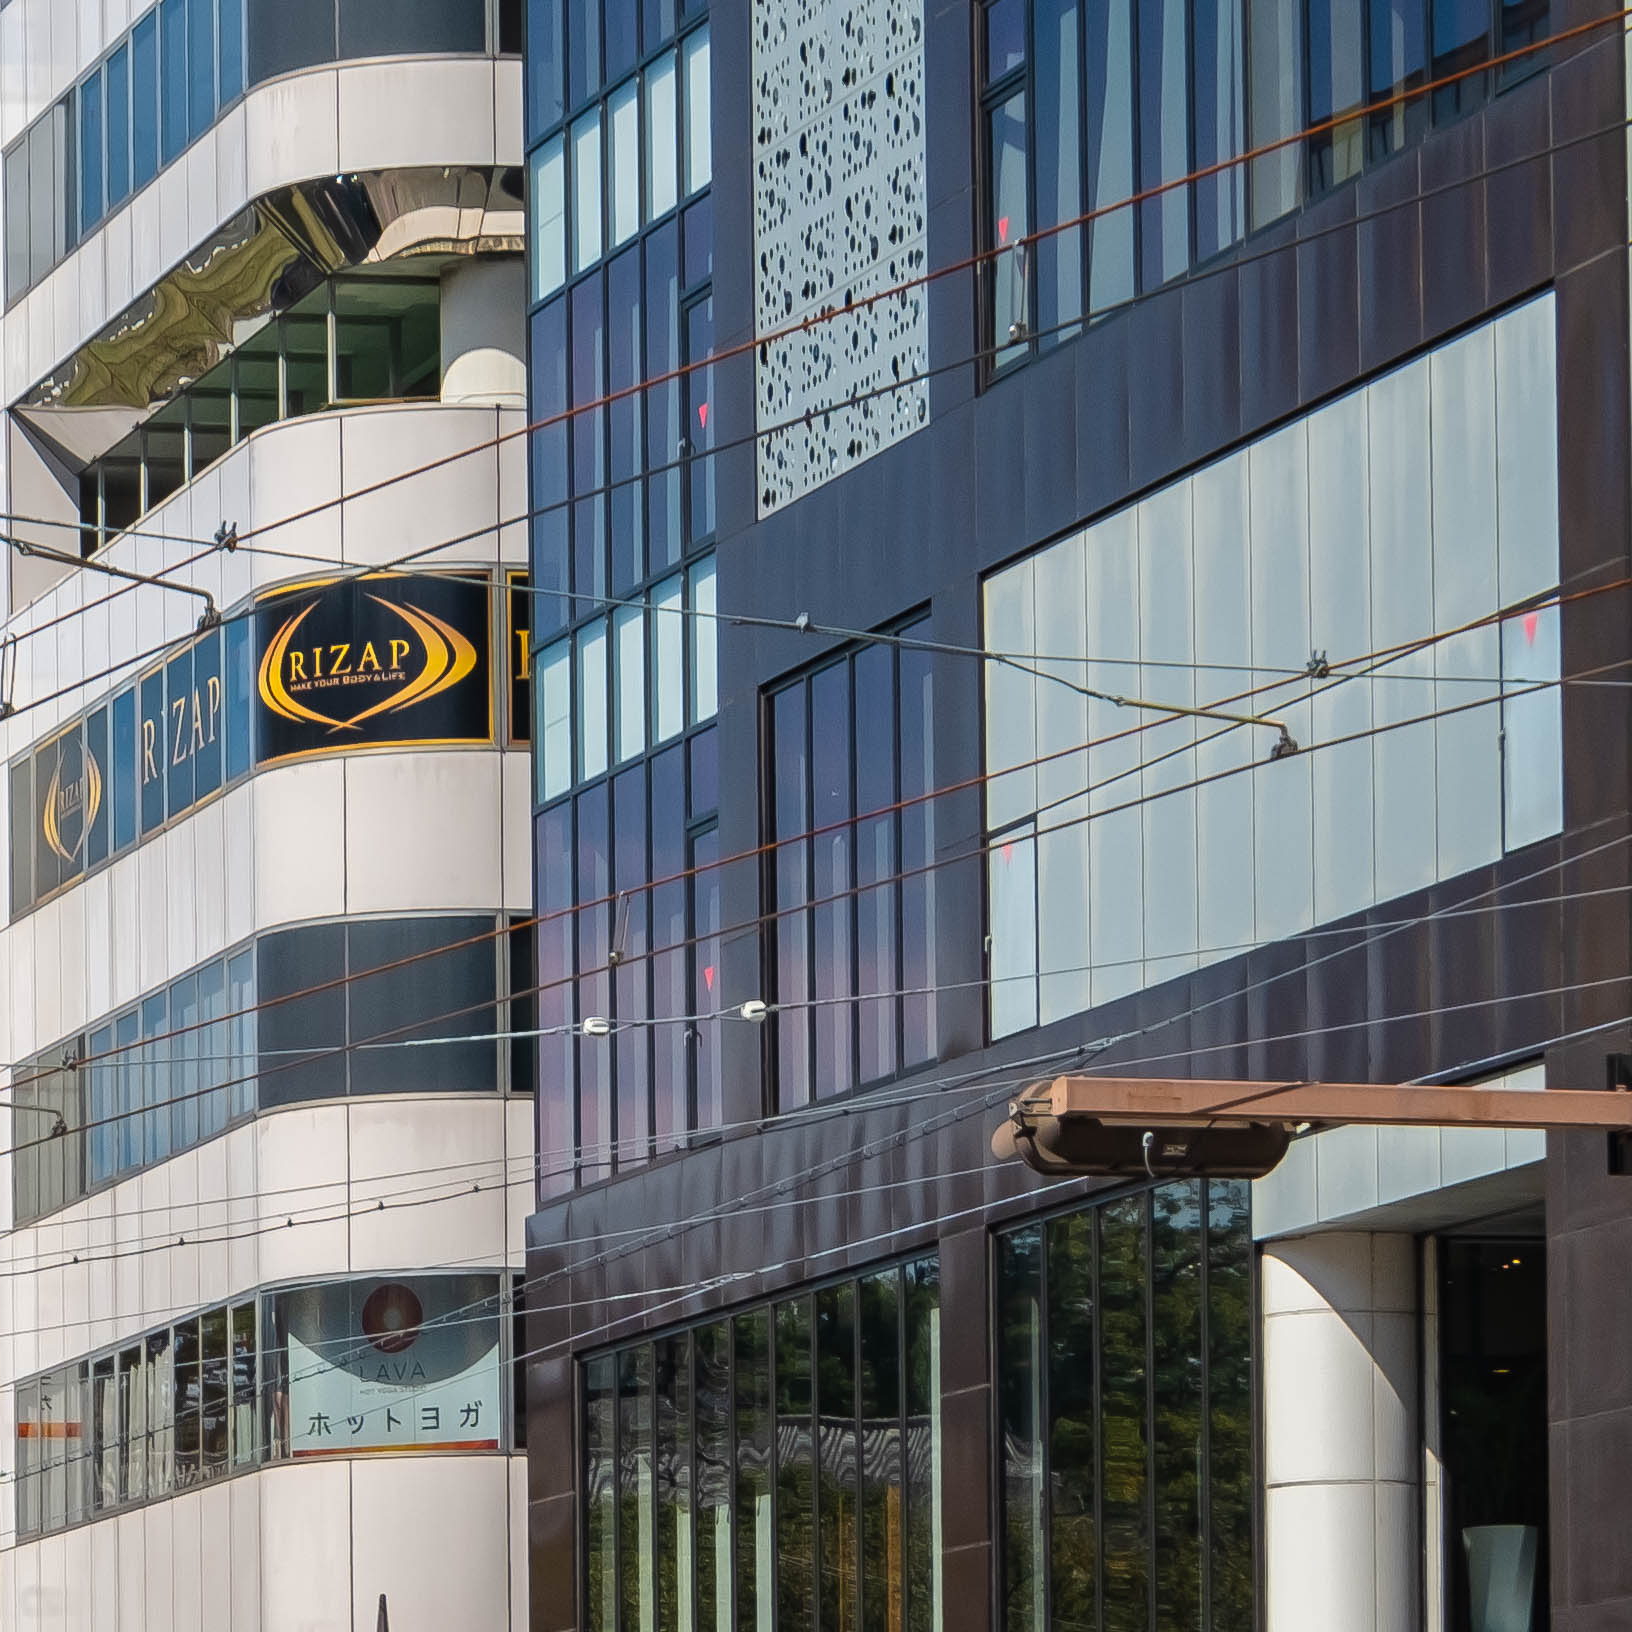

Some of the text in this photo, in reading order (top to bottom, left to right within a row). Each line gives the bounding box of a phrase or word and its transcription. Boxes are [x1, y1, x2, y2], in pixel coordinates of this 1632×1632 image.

[289, 639, 410, 682] RIZAP
[313, 678, 340, 688] YOUR
[143, 676, 221, 785] RZAP
[359, 1359, 427, 1383] LAVA
[307, 1399, 484, 1437] ホットヨガ
